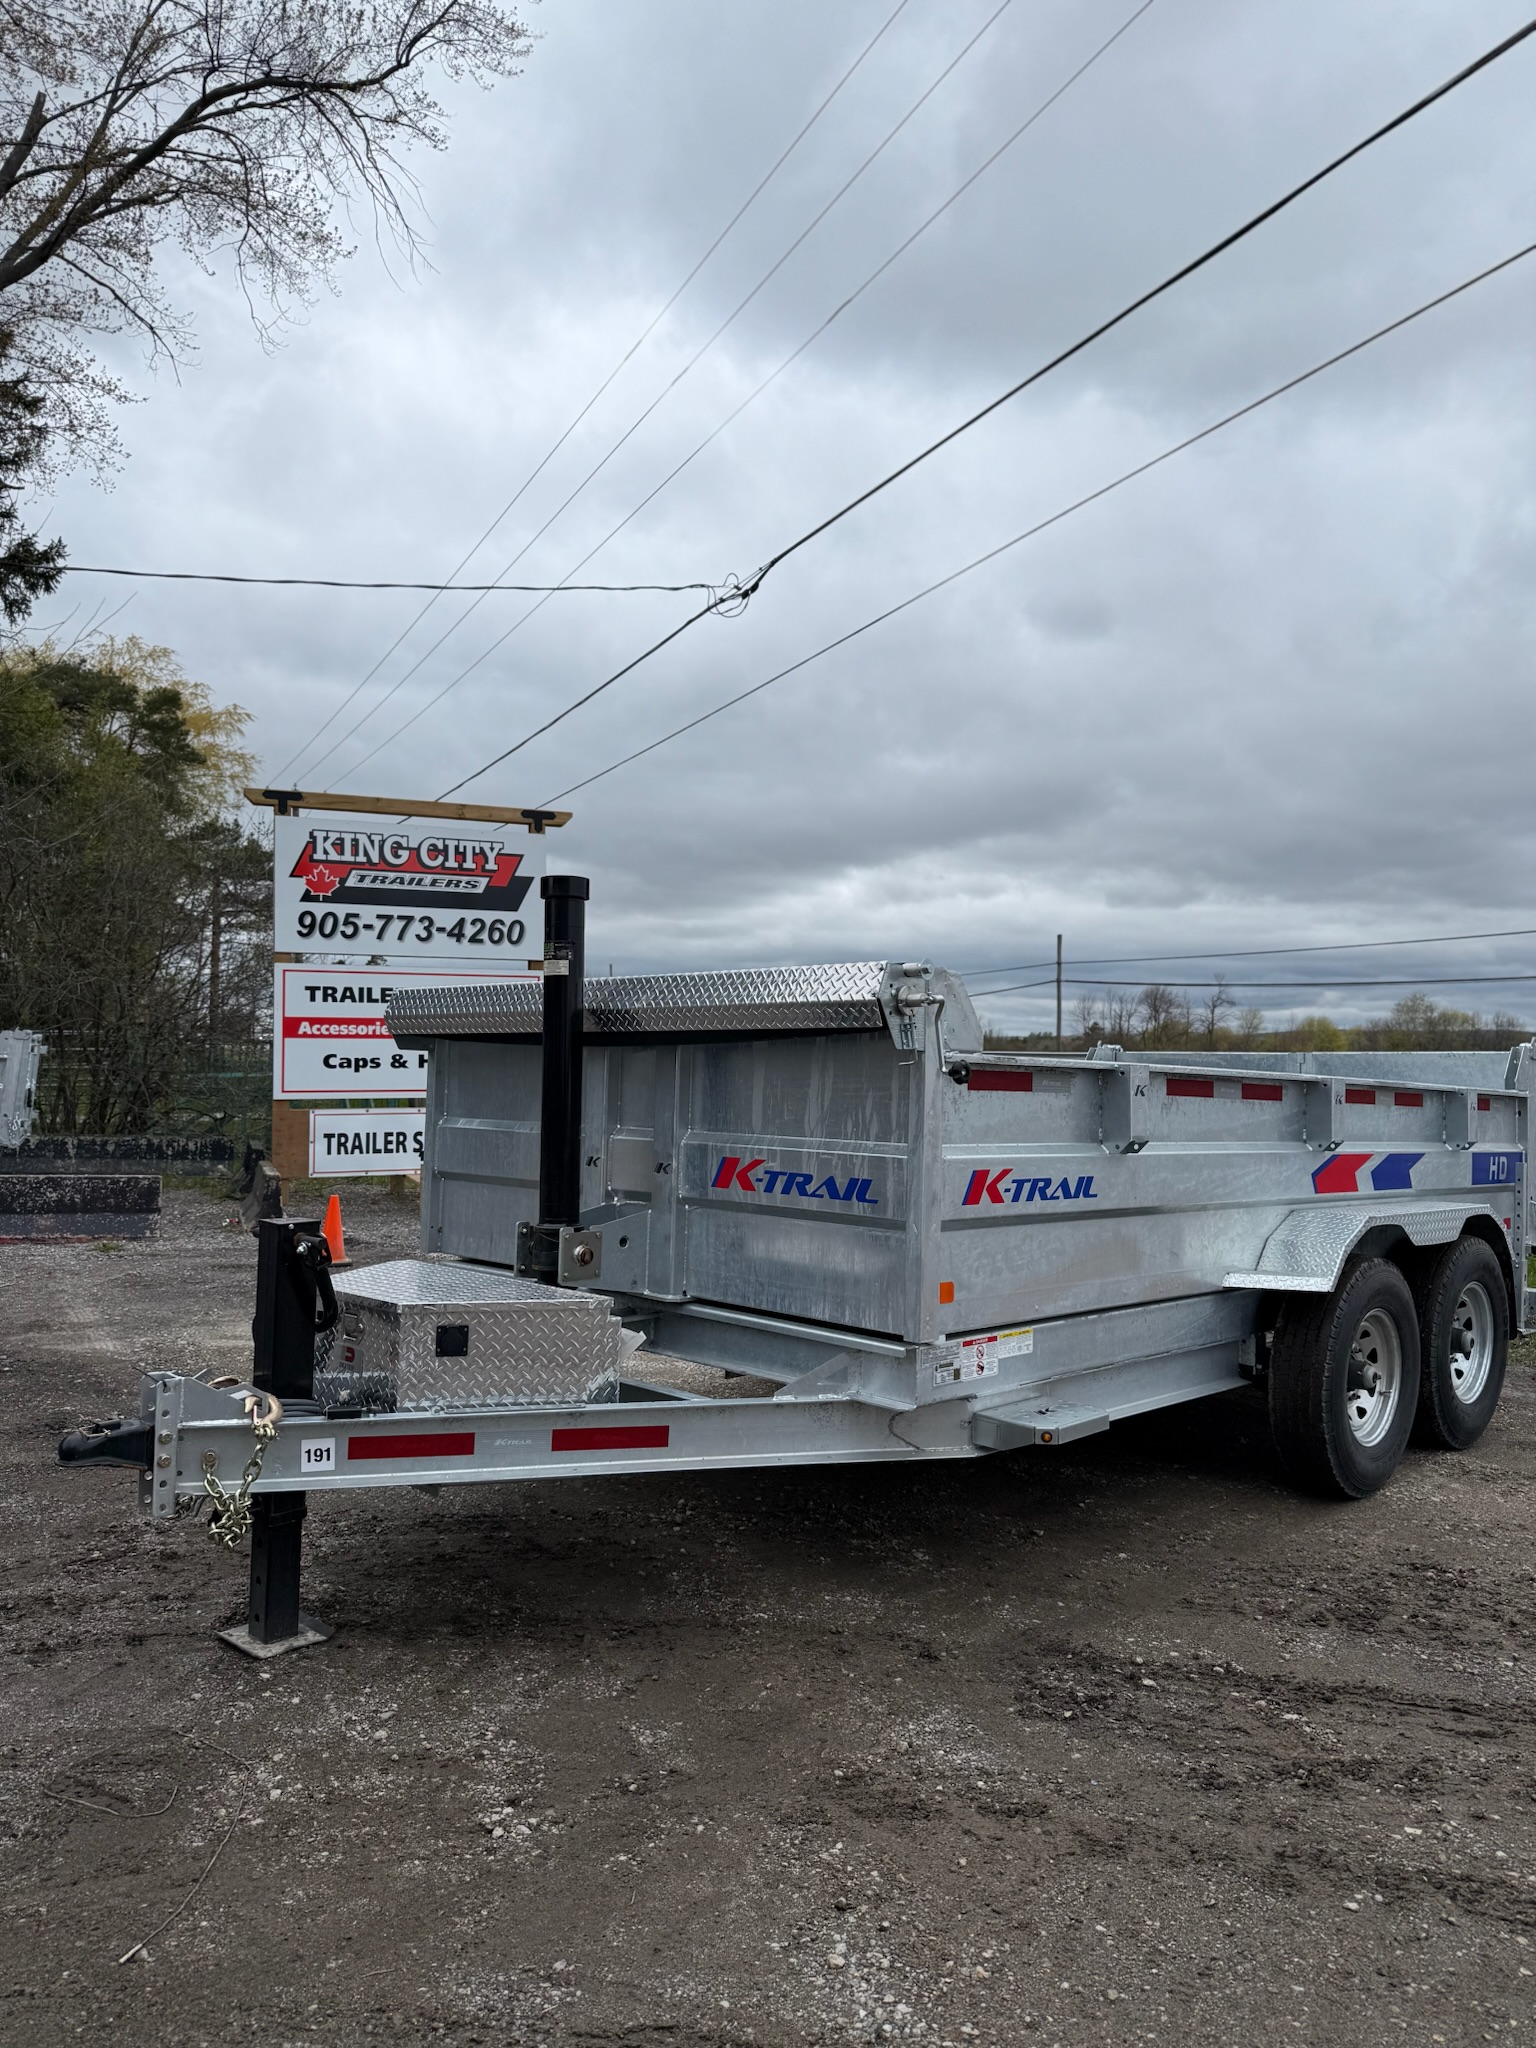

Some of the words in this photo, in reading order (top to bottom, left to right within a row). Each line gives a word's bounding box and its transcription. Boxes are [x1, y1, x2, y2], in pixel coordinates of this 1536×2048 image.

[310, 829, 411, 868] KING
[417, 836, 504, 871] CITY
[352, 872, 481, 891] TRAILERS
[296, 909, 526, 945] 905-773-4260
[322, 1053, 382, 1073] Caps
[390, 1053, 409, 1069] &
[323, 1131, 408, 1156] TRAILER
[711, 1156, 879, 1204] K-TRAIL
[1489, 1155, 1508, 1181] HD
[961, 1168, 1098, 1206] K-TRAIL
[304, 1446, 331, 1464] 191
